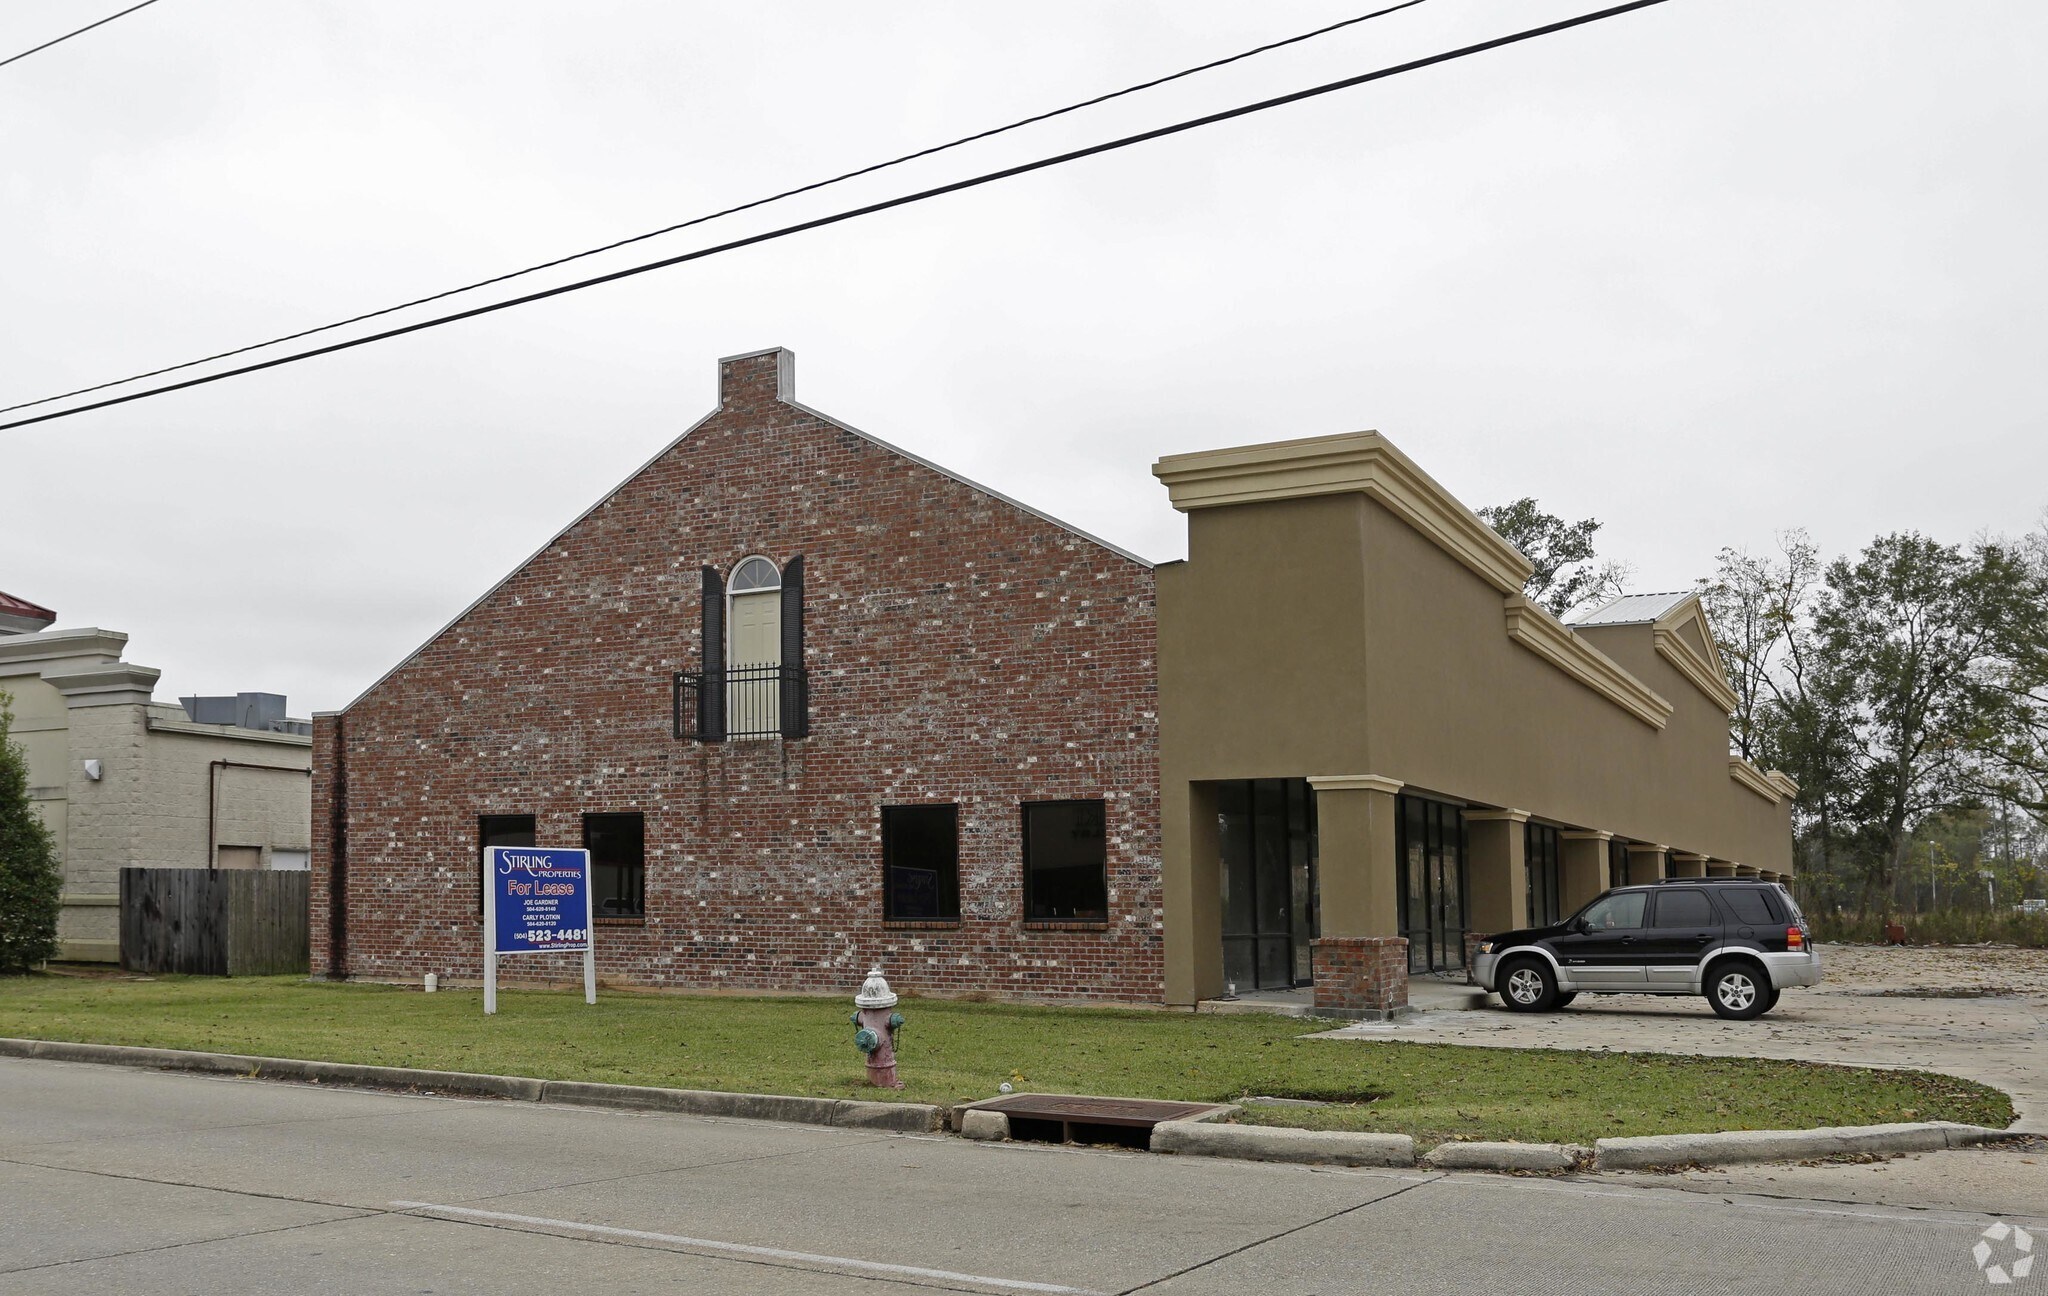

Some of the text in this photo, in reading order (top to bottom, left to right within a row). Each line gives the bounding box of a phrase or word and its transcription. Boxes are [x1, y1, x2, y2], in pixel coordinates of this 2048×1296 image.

[500, 851, 552, 877] STIRLING
[538, 871, 582, 879] PROPERTIES
[508, 880, 574, 895] For Lease
[514, 929, 587, 942] (504) 523-4481
